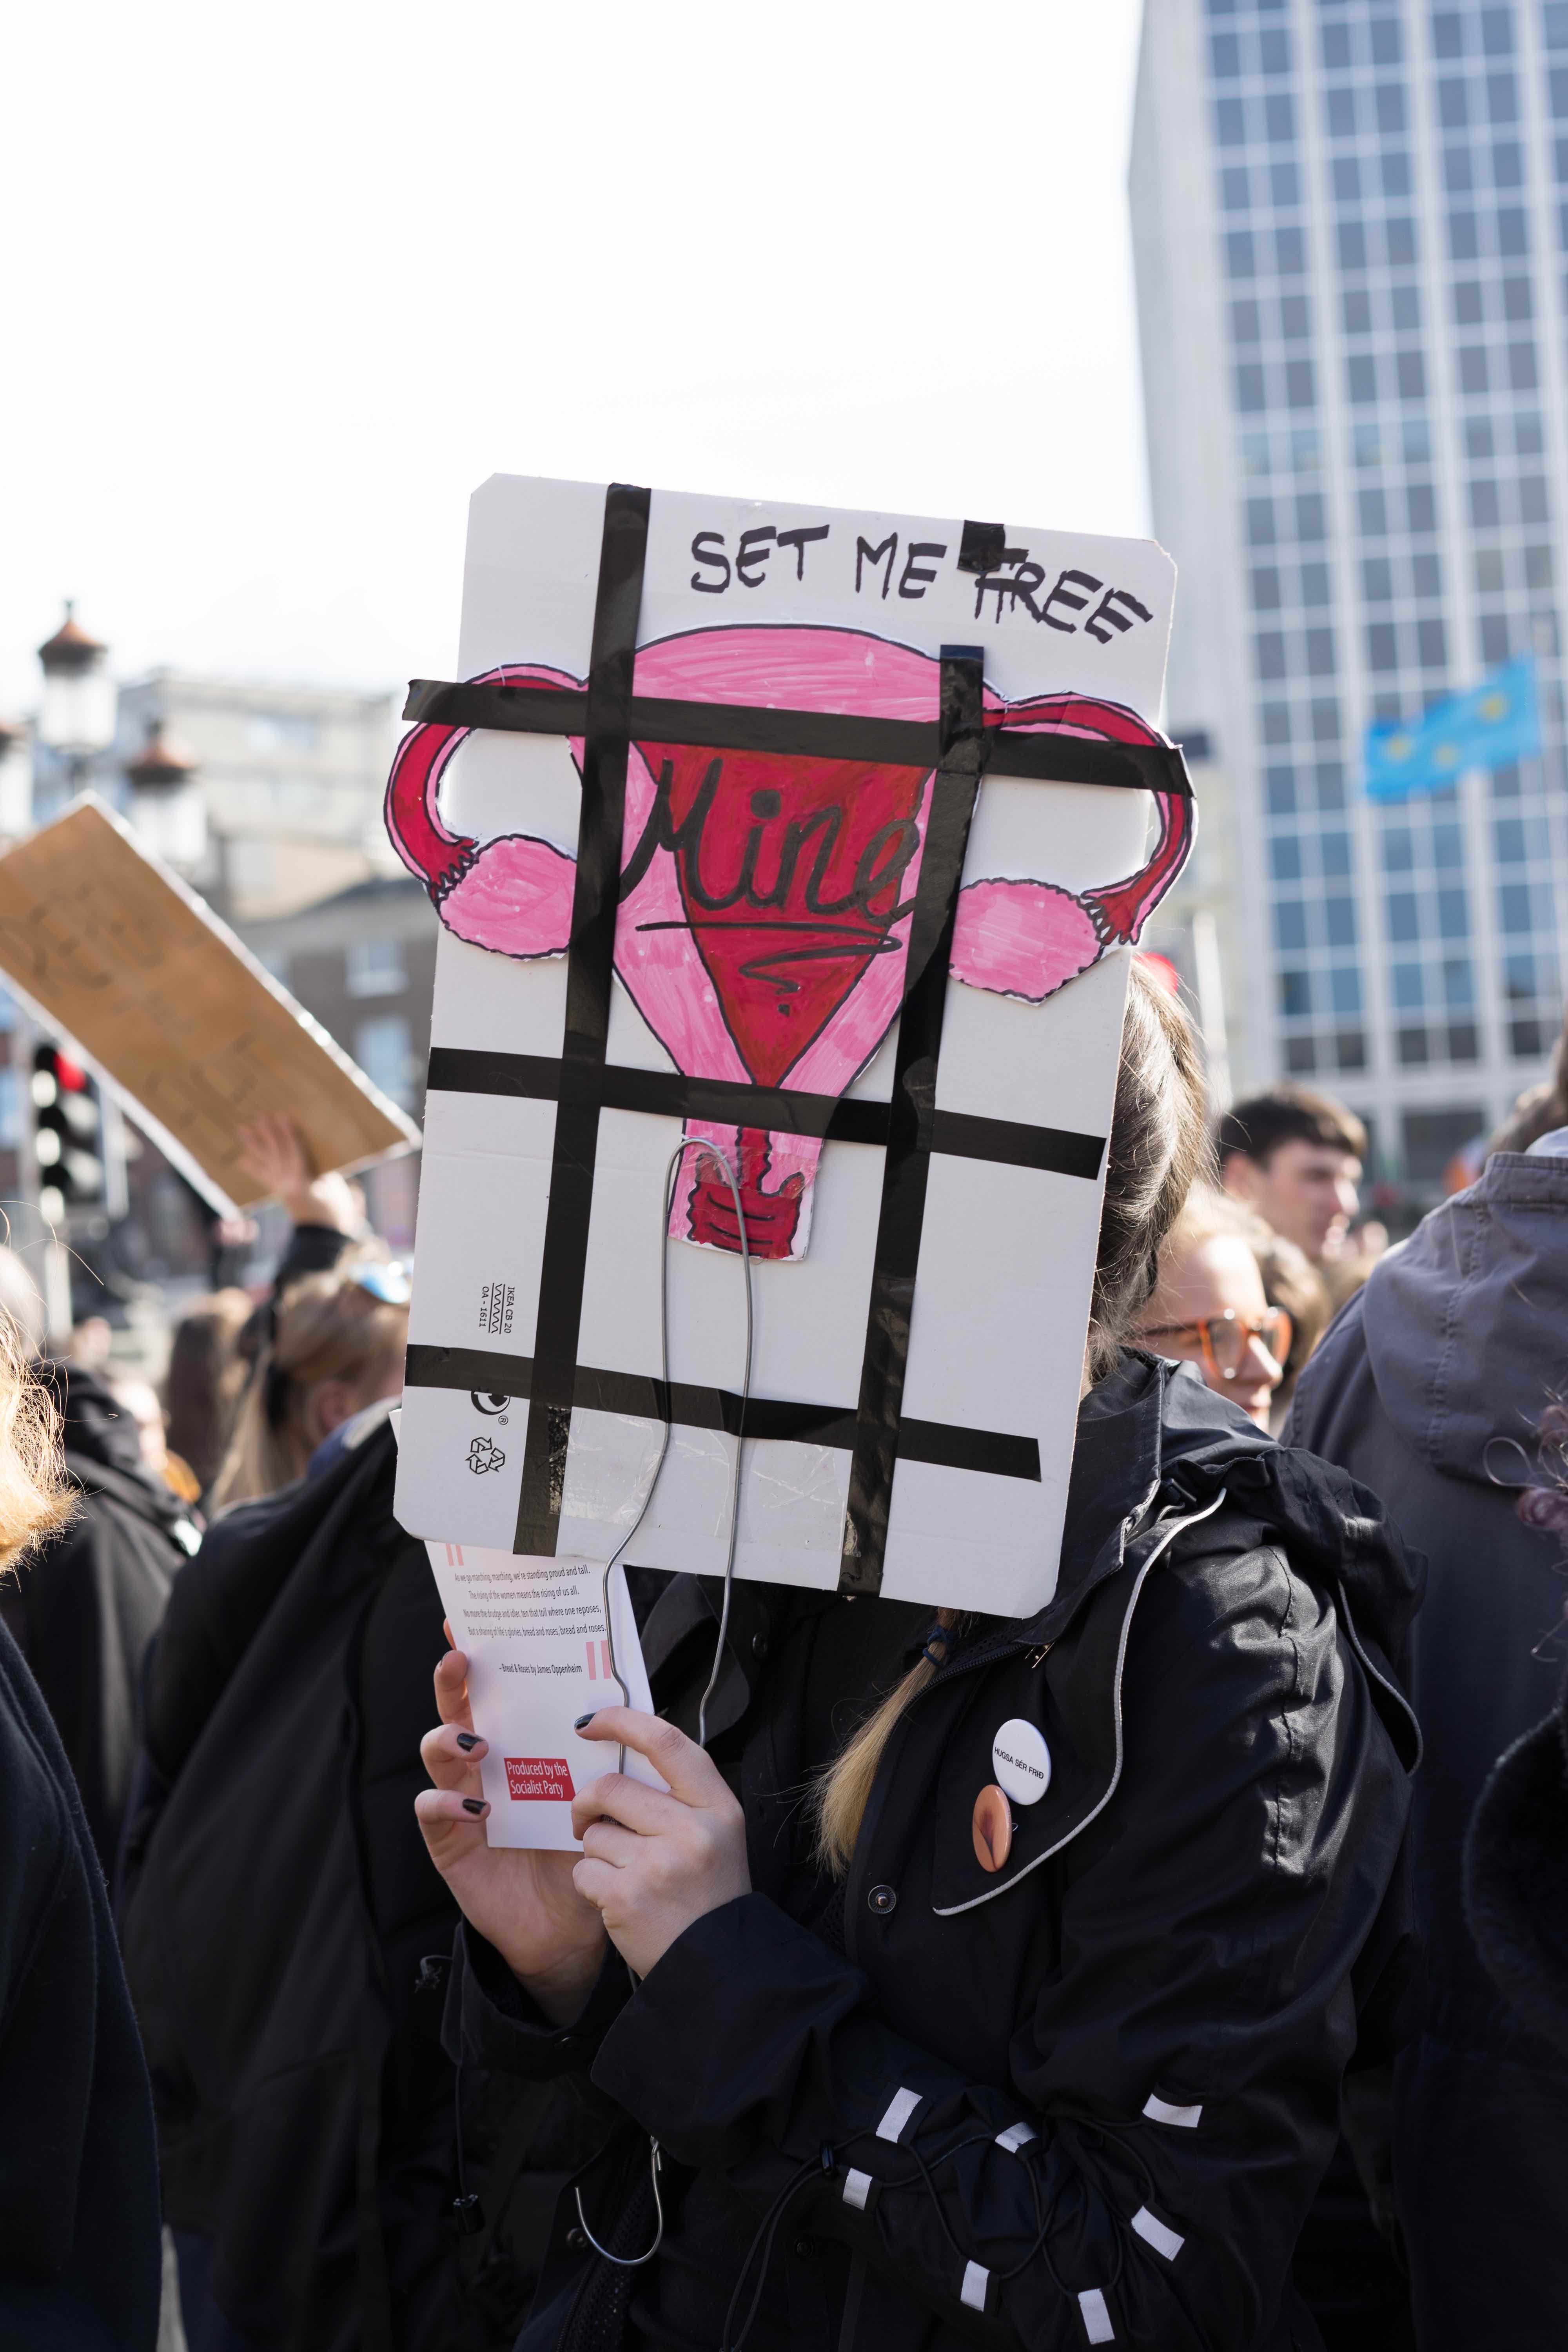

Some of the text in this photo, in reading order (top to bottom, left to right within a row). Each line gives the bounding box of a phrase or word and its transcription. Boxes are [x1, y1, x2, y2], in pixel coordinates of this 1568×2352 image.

[690, 524, 1153, 644] SET ME FREE
[619, 757, 920, 927] Mine
[504, 1287, 515, 1333] IKEA CB 20
[466, 1574, 472, 1583] go
[526, 1569, 548, 1580] standing
[549, 1567, 565, 1580] proud
[566, 1566, 577, 1576] and
[578, 1564, 590, 1575] tall.
[468, 1590, 477, 1599] The
[477, 1590, 489, 1602] rising
[488, 1590, 492, 1599] of
[492, 1590, 500, 1599] the
[532, 1589, 540, 1598] the
[541, 1588, 555, 1599] rising
[556, 1587, 561, 1597] of
[570, 1585, 579, 1595] all.
[463, 1609, 470, 1617] No
[501, 1609, 510, 1617] and
[530, 1608, 539, 1617] that
[539, 1608, 548, 1617] toil
[548, 1607, 564, 1616] where
[576, 1605, 601, 1616] reposes,
[522, 1626, 534, 1636] bread
[536, 1626, 545, 1636] and
[545, 1628, 560, 1636] roses,
[560, 1625, 575, 1635] bread
[577, 1624, 588, 1634] and
[588, 1624, 607, 1632] roses.
[518, 1664, 530, 1673] Roses
[530, 1664, 537, 1675] by
[537, 1664, 551, 1673] James
[551, 1663, 582, 1676] Oppenheim
[507, 1761, 568, 1779] Produced by the
[995, 1746, 1044, 1779] HUGSA SÉR FRIÐ
[510, 1780, 563, 1798] Socialist Party
